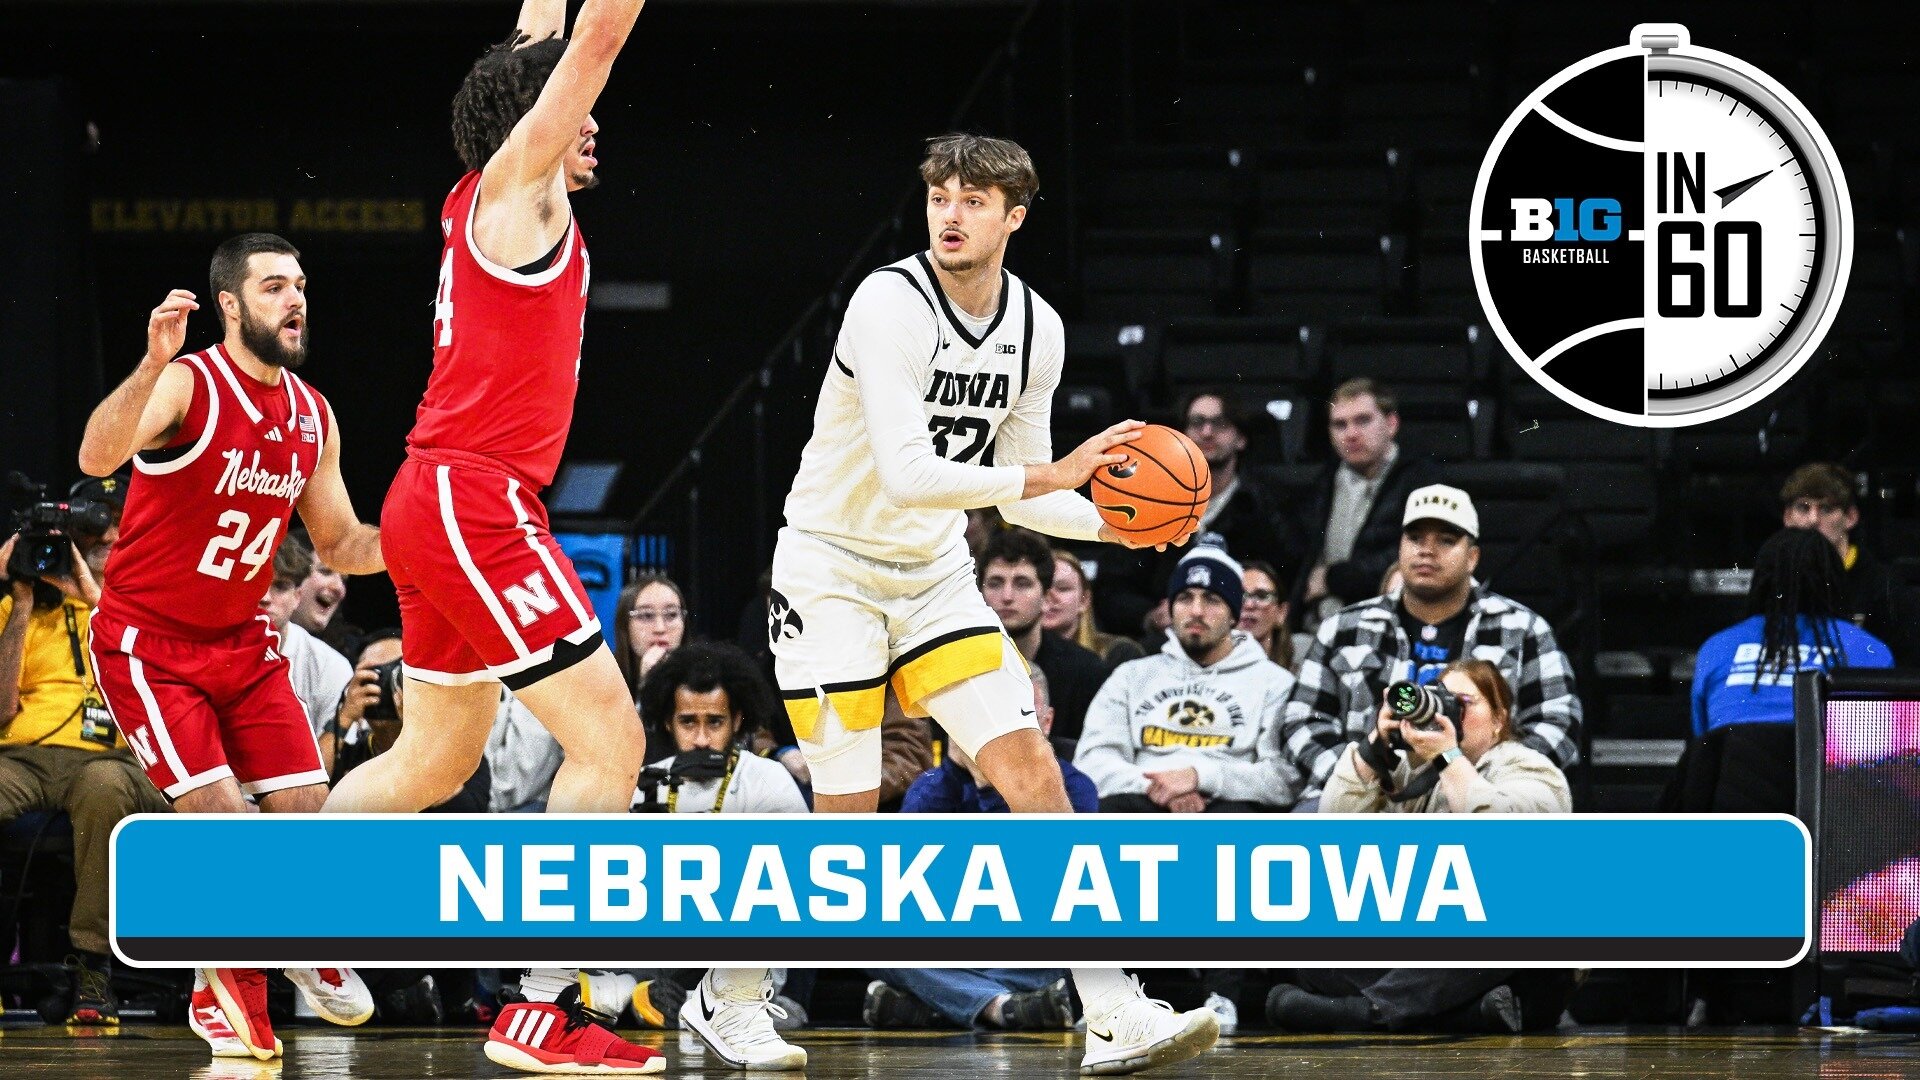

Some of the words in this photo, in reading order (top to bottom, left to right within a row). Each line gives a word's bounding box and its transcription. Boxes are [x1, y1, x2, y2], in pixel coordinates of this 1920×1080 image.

[91, 200, 277, 231] ELEVATOR
[290, 200, 426, 231] ACCESS
[924, 368, 1010, 409] IOWA
[928, 414, 992, 464] 32
[214, 447, 307, 507] Nebraska
[198, 508, 282, 582] 24
[501, 569, 561, 629] N
